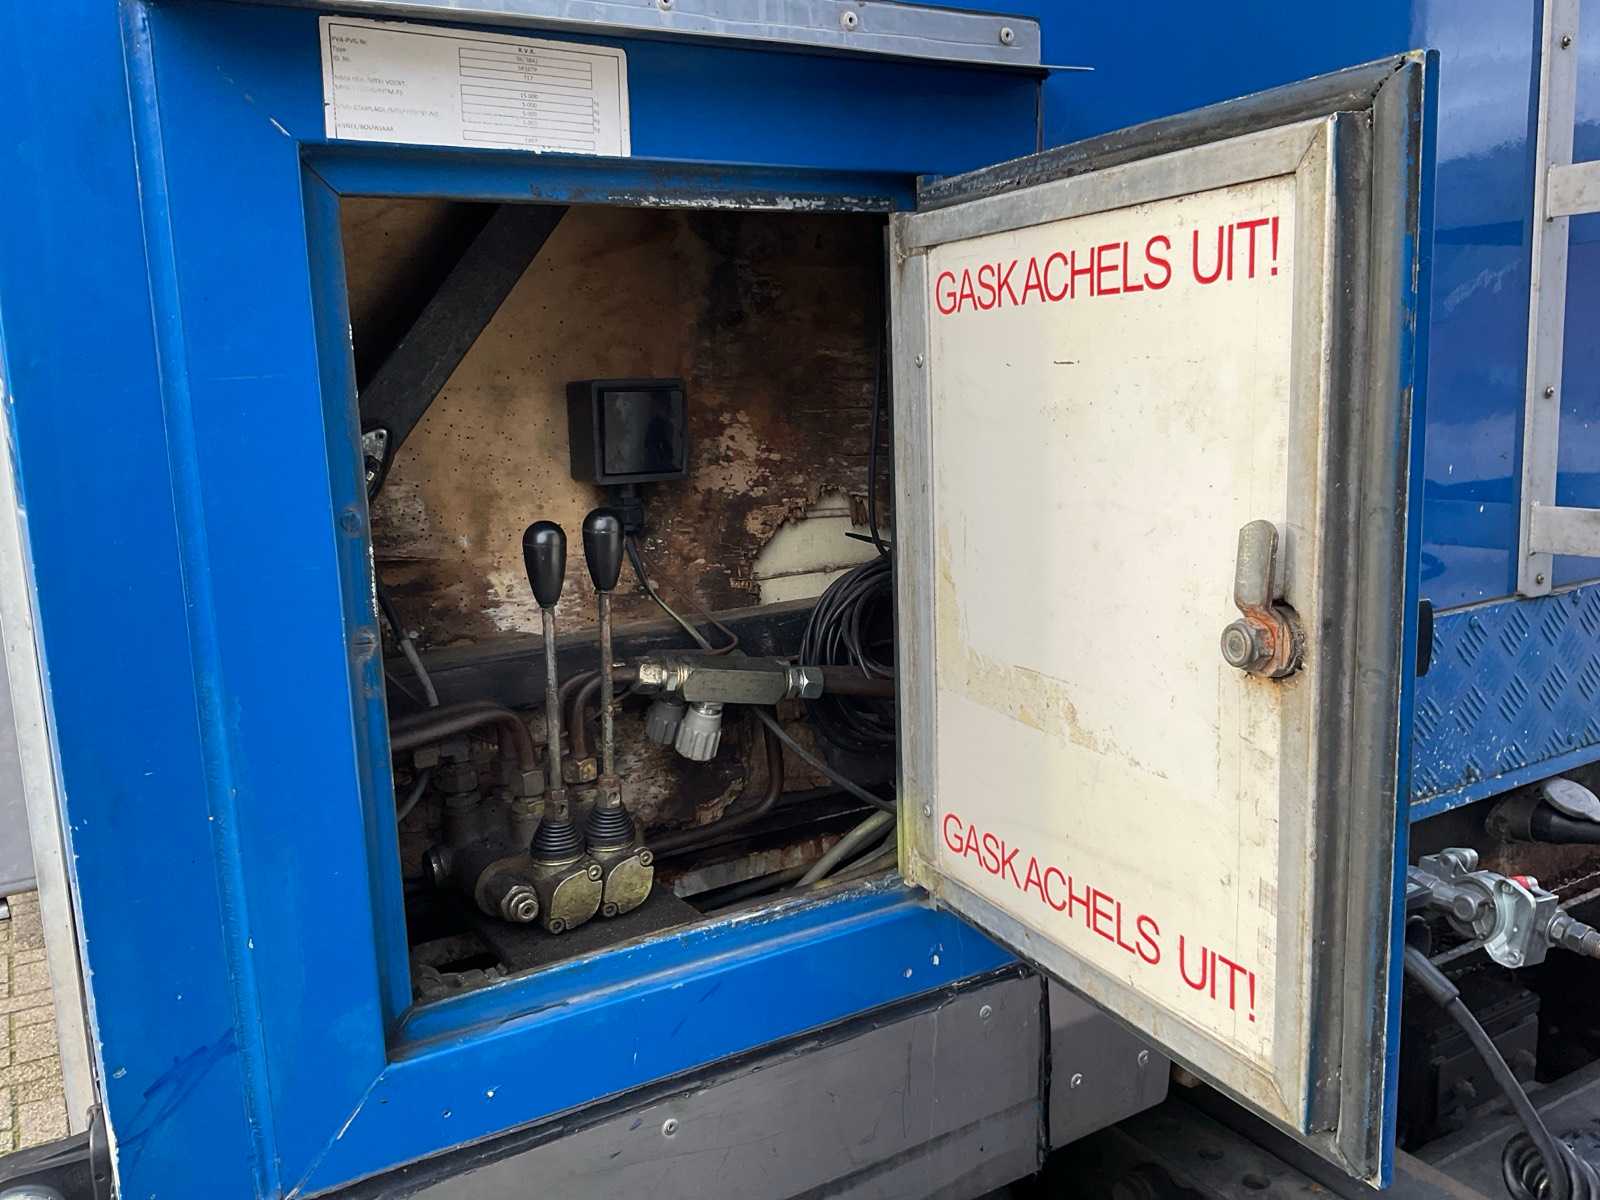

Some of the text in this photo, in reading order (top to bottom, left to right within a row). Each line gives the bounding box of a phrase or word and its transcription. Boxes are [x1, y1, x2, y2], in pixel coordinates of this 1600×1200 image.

[935, 215, 1280, 316] GASKACHELS UIT!
[943, 812, 1257, 1022] GASKACHELS UIT!
